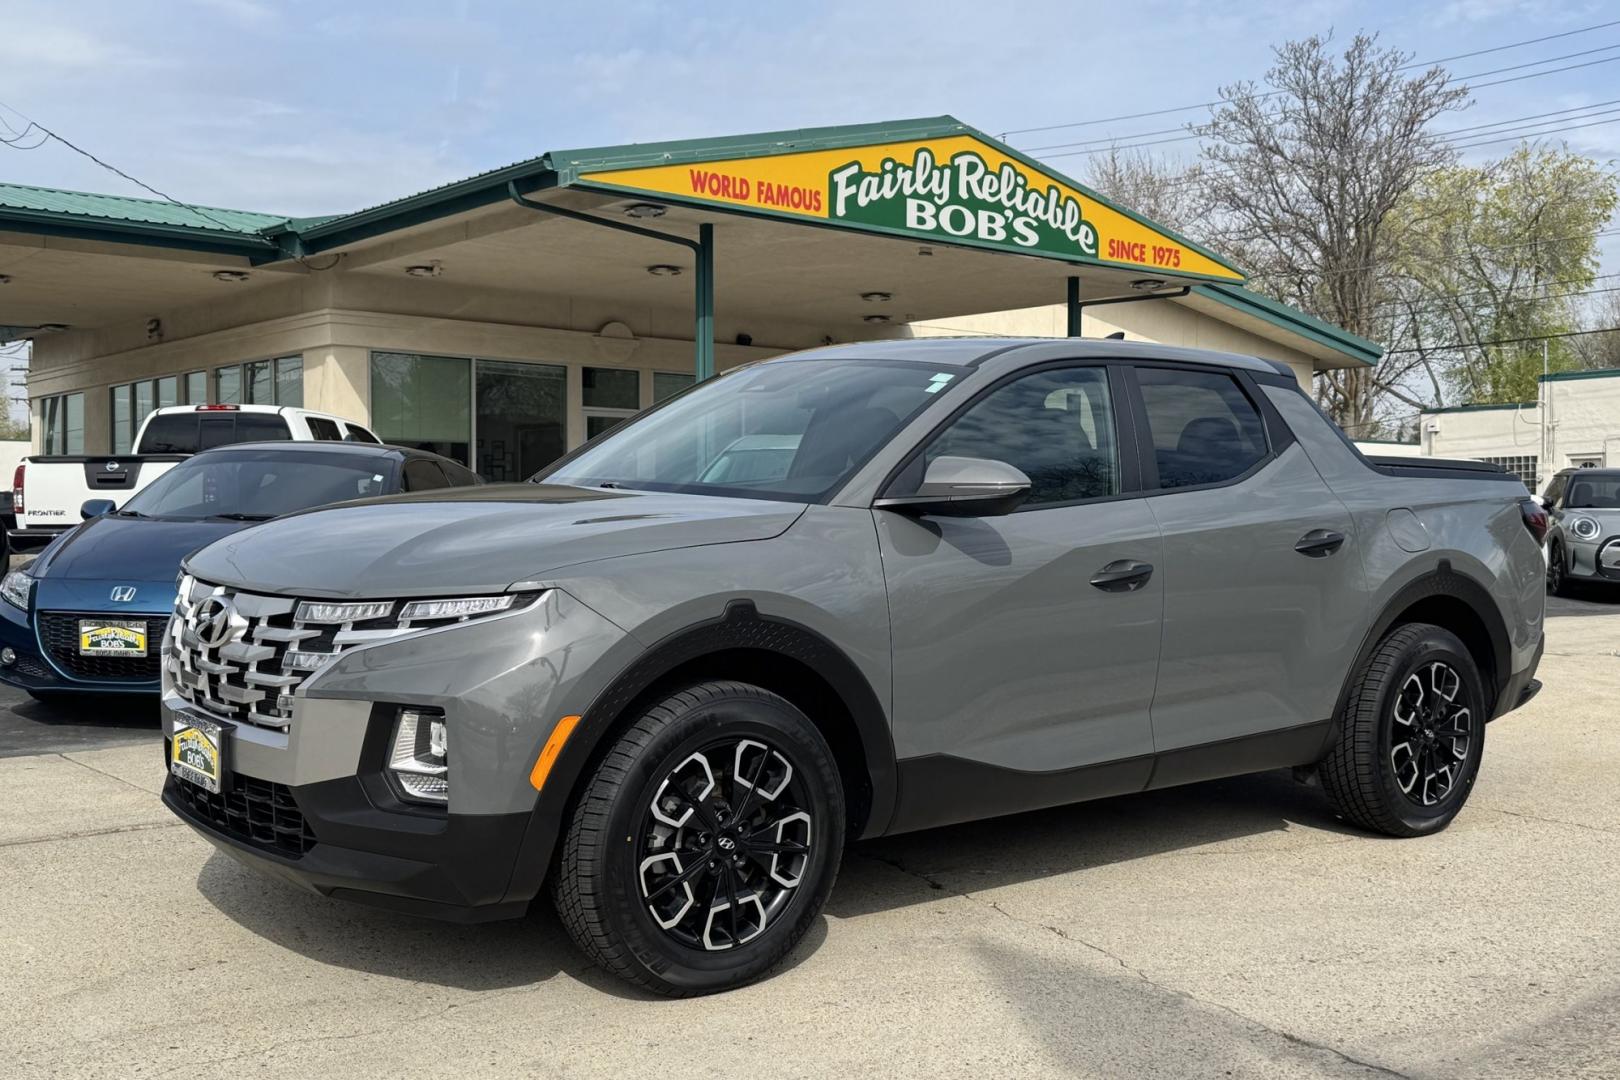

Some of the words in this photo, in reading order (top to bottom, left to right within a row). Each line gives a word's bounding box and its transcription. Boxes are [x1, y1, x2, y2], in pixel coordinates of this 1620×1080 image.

[689, 168, 750, 201] WORLD
[756, 180, 822, 212] FAMOUS
[832, 150, 950, 217] Fairly
[953, 153, 1096, 254] Reliable
[905, 197, 1040, 247] BOB'S
[1108, 238, 1146, 263] SINCE
[1152, 245, 1181, 268] 1975
[27, 509, 66, 517] FRONTIER
[100, 639, 125, 648] BOB'S
